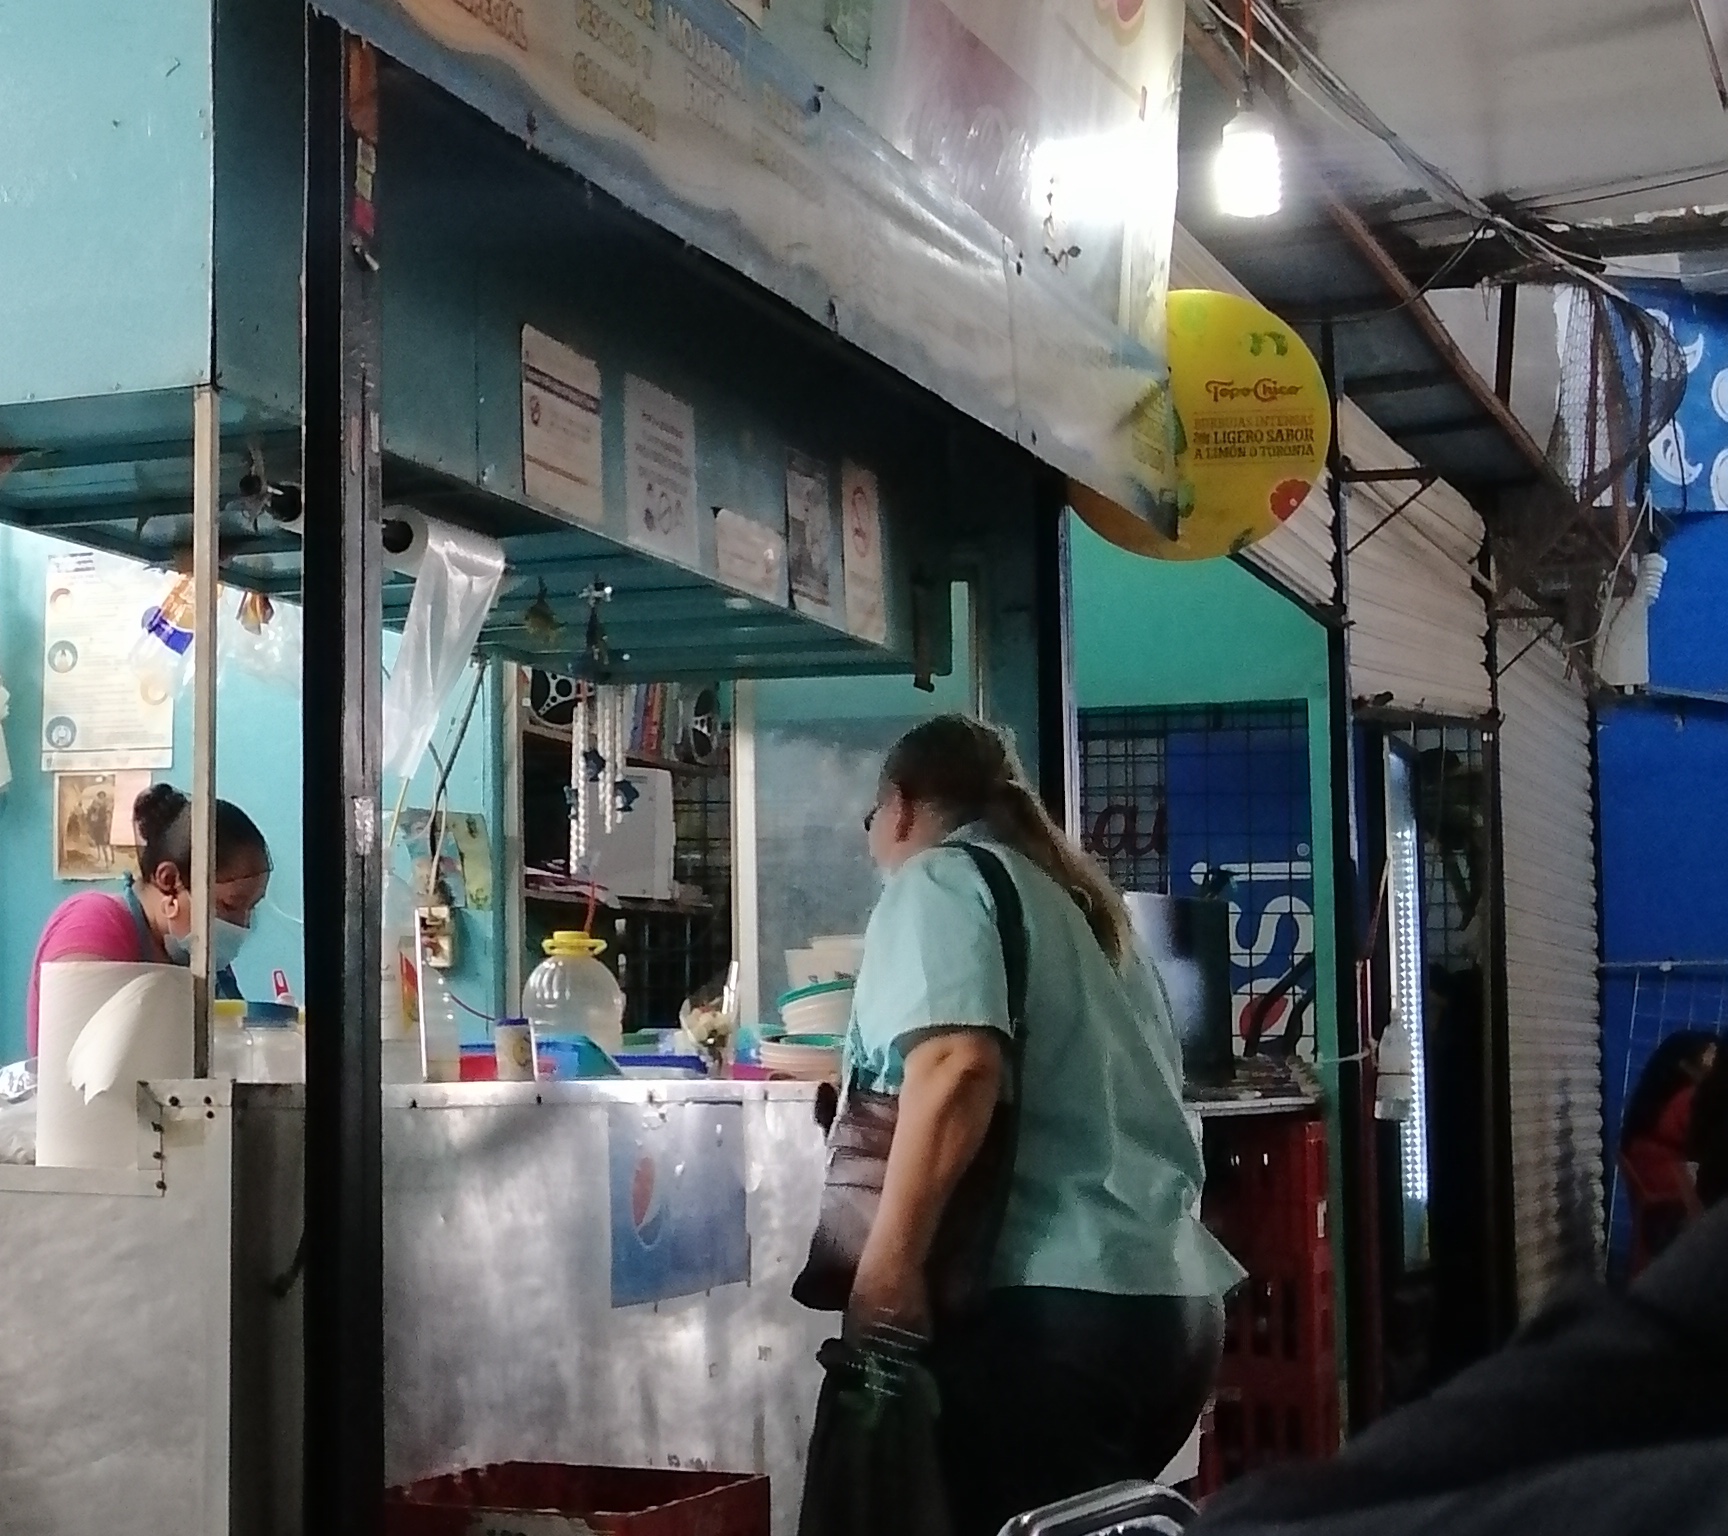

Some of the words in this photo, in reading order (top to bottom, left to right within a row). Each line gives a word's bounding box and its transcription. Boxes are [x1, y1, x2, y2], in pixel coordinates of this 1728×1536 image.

[1205, 380, 1252, 402] Topo
[1253, 378, 1303, 402] Chico
[1213, 430, 1264, 444] LIGERO
[1267, 428, 1314, 443] SABOR
